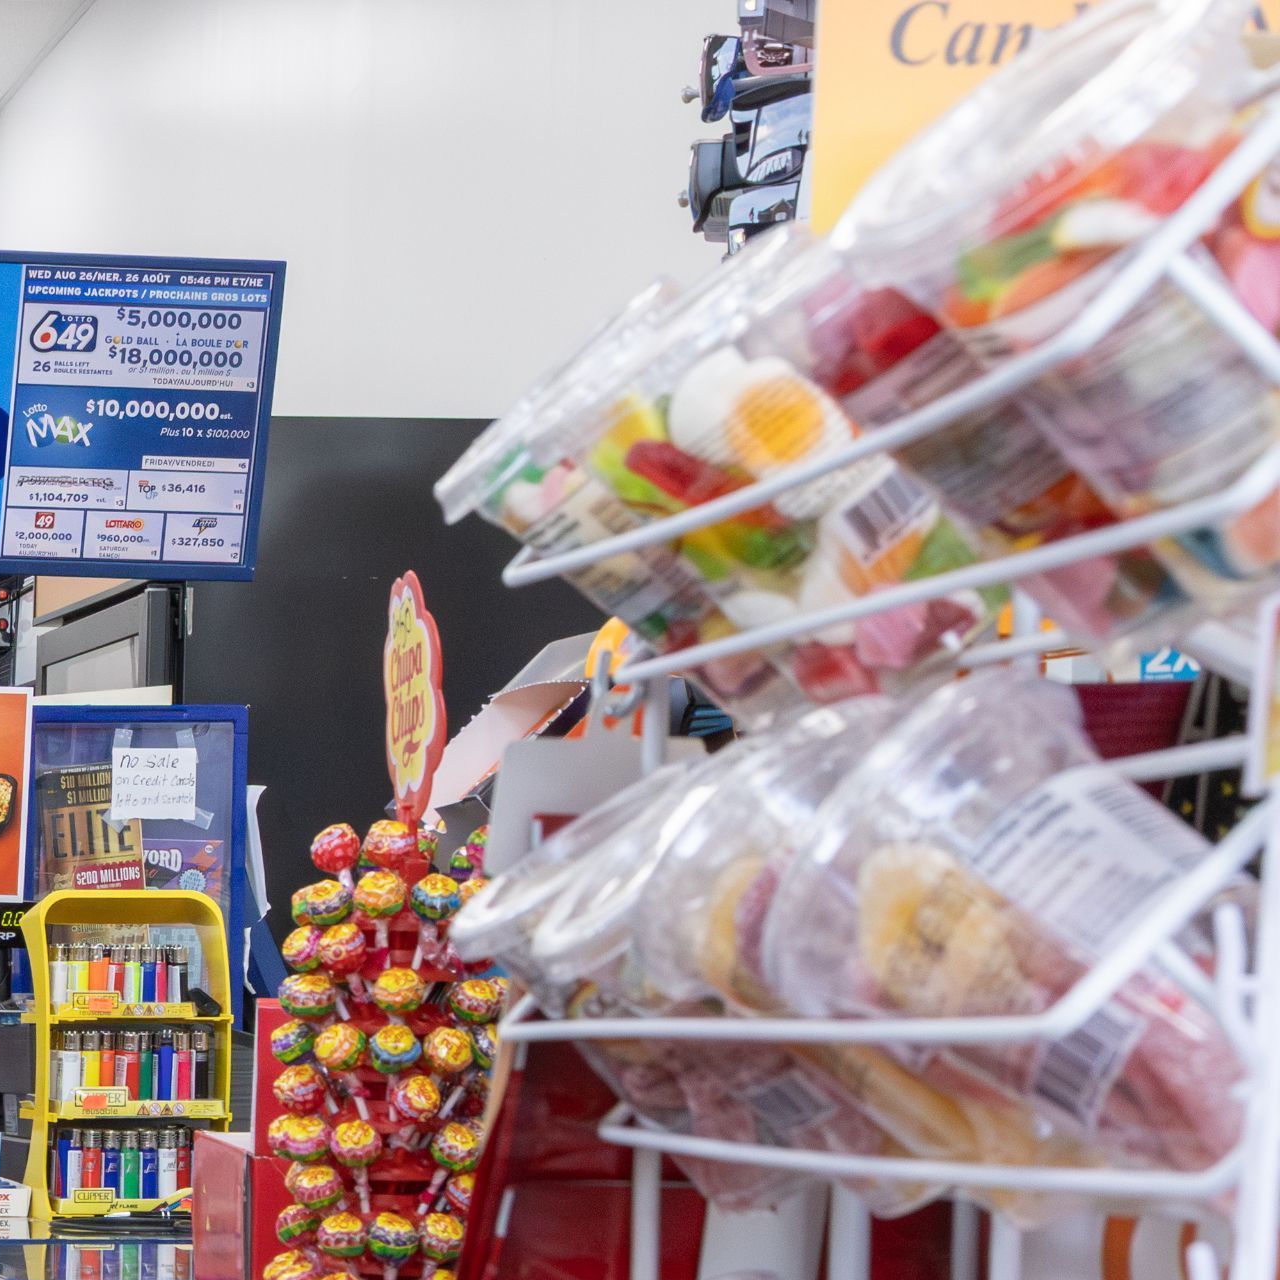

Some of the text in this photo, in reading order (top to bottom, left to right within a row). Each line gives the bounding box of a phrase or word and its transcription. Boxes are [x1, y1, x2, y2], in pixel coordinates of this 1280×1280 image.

[29, 270, 263, 287] WED AUG 26/MER. 26 AOÛT 05:46 PM ET/HE
[28, 285, 267, 303] UPCOMING JACKPOTS PROCHAINS GROS LOTS
[117, 307, 242, 331] $5,000,000
[137, 337, 159, 346] BALL
[176, 338, 187, 347] LA
[192, 339, 222, 348] BOULE
[108, 347, 242, 369] $18,000,000
[33, 360, 50, 372] 26
[86, 399, 219, 420] $10,000,000
[26, 413, 93, 448] MAX
[160, 427, 250, 439] Plus 10 x $100,000
[162, 484, 206, 494] $36,416
[29, 493, 88, 503] $1,104,709
[15, 532, 72, 541] $2,000,000
[97, 534, 143, 543] $960,000
[172, 537, 225, 548] $327,850
[391, 641, 422, 696] Chupa
[392, 689, 425, 746] Chups
[132, 775, 166, 787] Credit
[76, 866, 140, 884] $200 MILLIONS
[77, 1193, 112, 1201] CLIPPER
